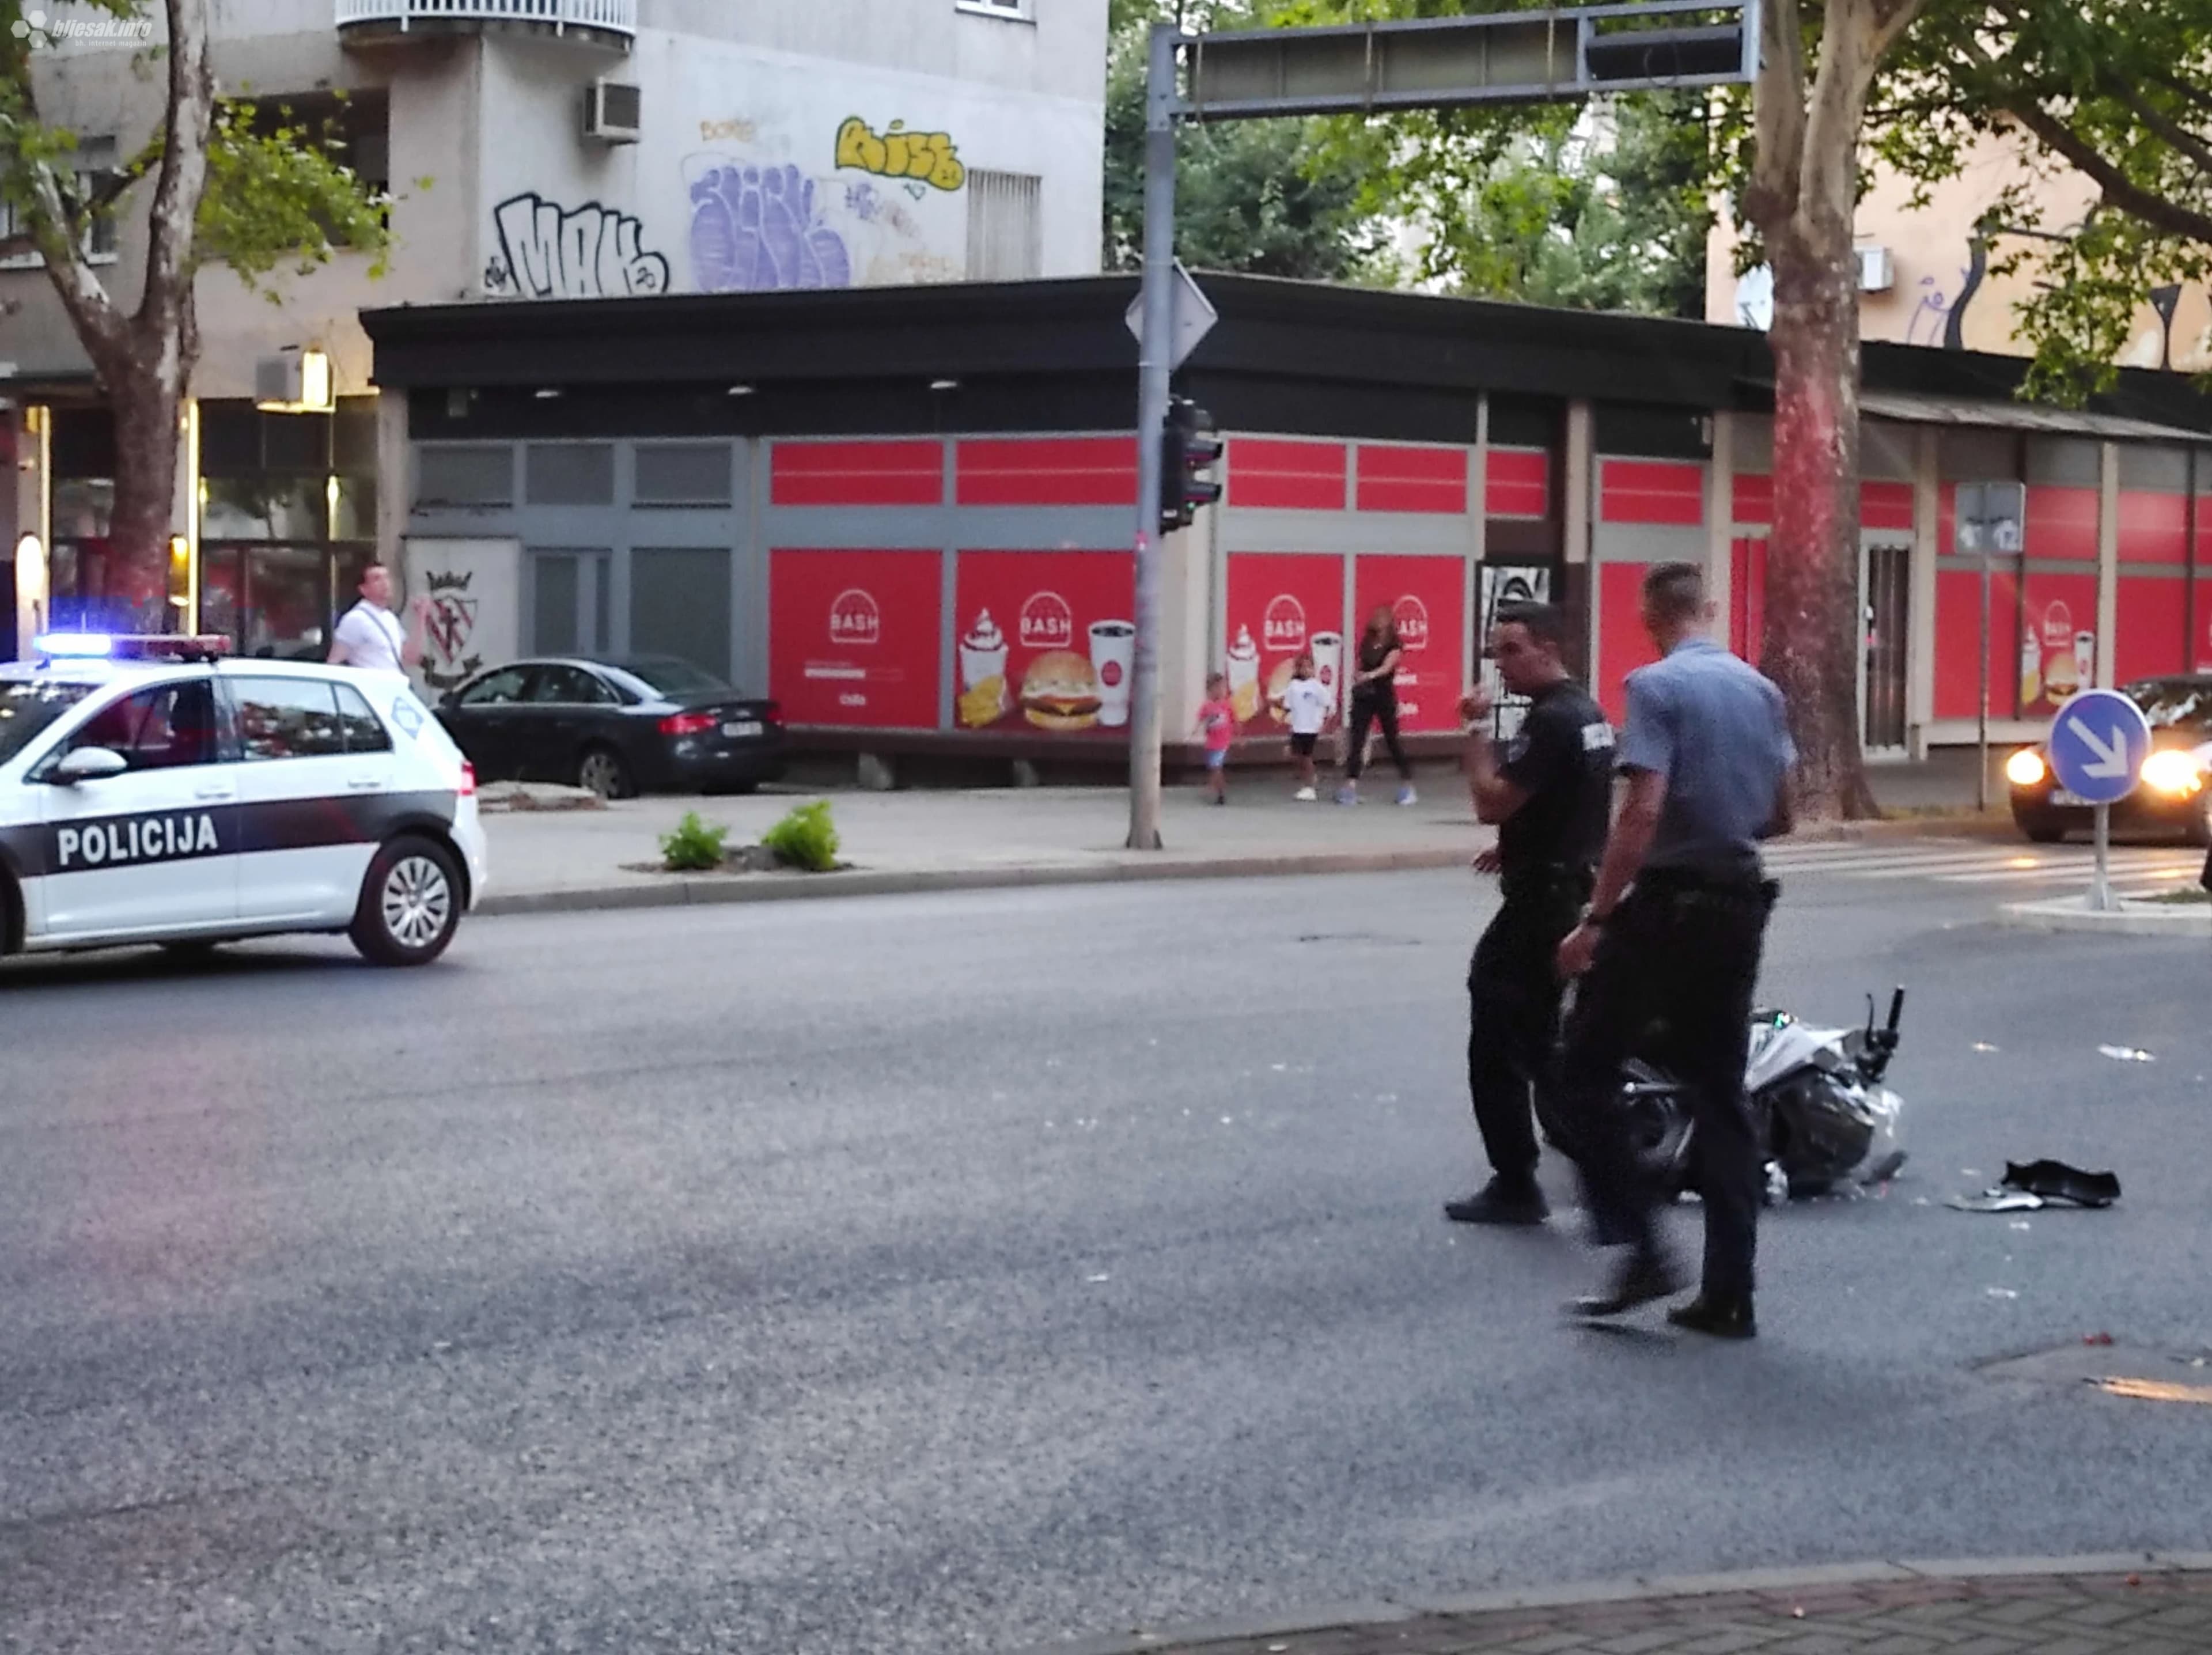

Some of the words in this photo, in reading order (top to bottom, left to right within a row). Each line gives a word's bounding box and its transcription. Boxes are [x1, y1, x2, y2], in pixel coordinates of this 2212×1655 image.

[830, 613, 878, 631] BASH
[1020, 617, 1071, 635] BASH
[1265, 619, 1305, 637] BASH
[1396, 619, 1427, 636] ASH
[58, 814, 218, 865] POLICIJA
